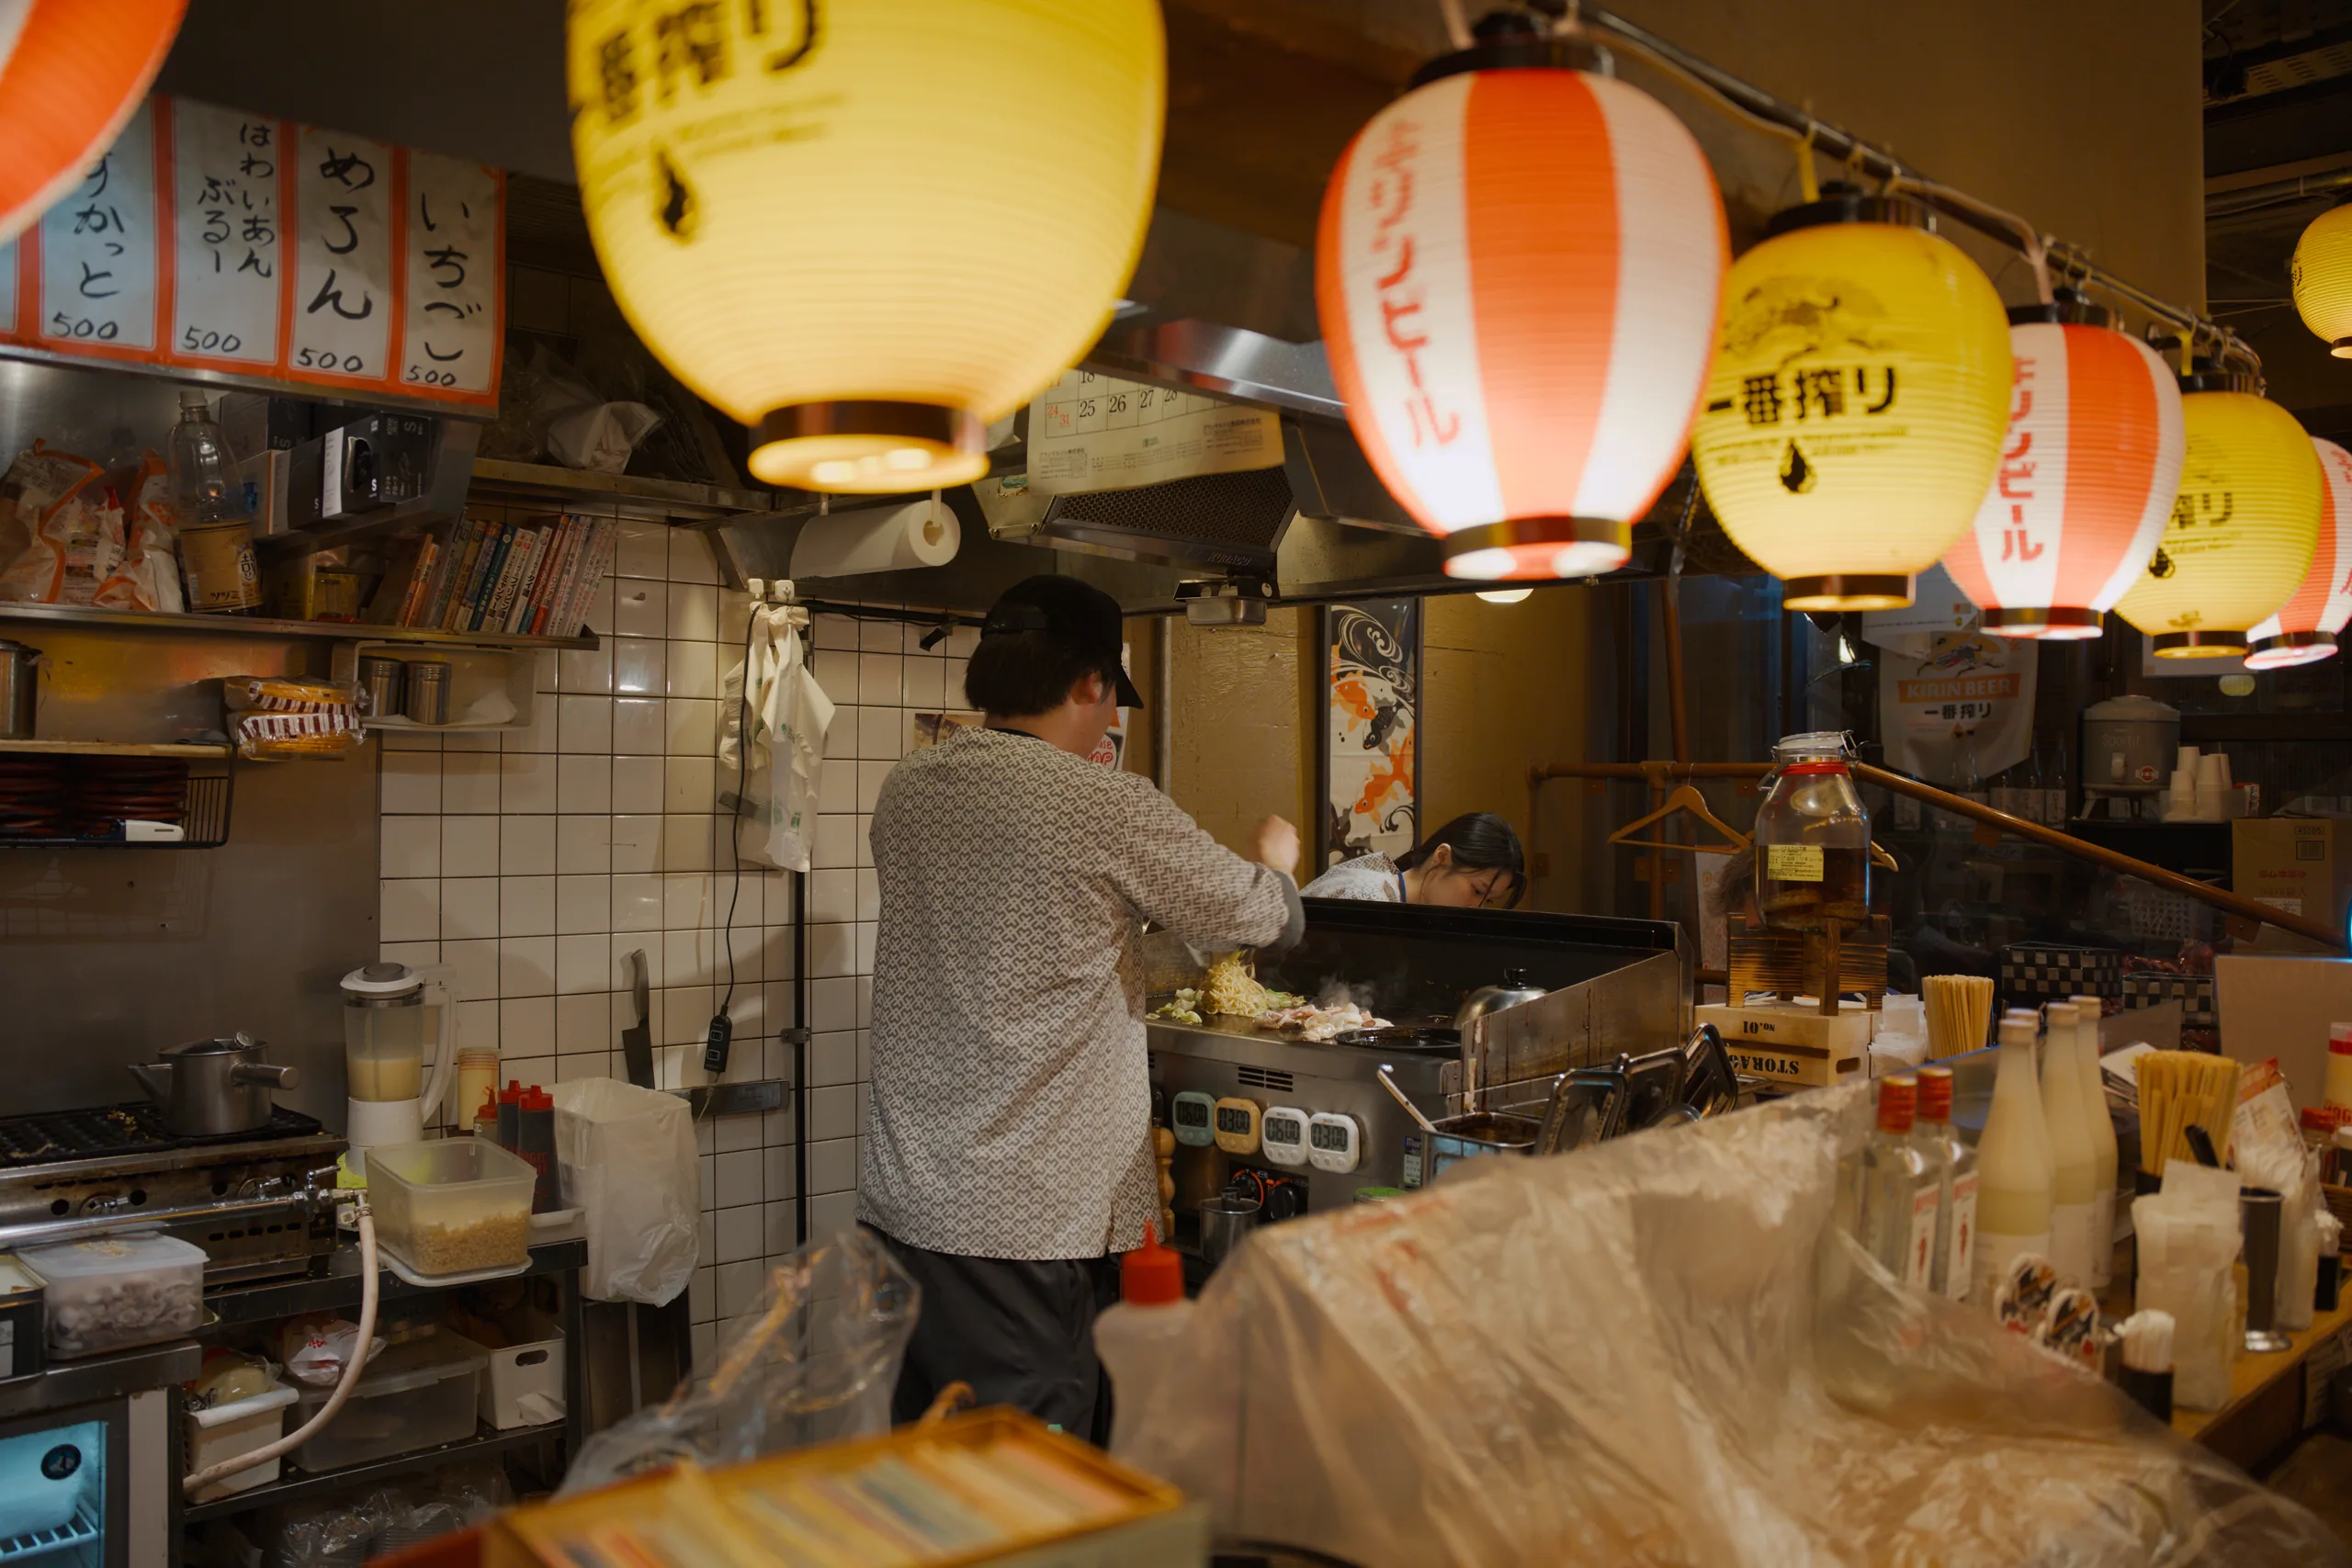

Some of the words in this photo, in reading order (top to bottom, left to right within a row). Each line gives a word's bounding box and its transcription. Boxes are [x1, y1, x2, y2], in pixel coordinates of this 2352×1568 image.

[238, 122, 275, 278] はわいあん
[74, 152, 126, 299] すかっと
[197, 175, 236, 274] ぶるー
[306, 147, 375, 321] めろん
[421, 191, 482, 362] いちご
[51, 310, 119, 341] 500
[182, 326, 242, 355] 500
[297, 347, 364, 374] 500
[405, 365, 458, 388] 500
[1079, 400, 1096, 418] 25
[1109, 394, 1127, 414] 26
[1139, 389, 1155, 409] 27
[1707, 367, 1897, 426] 一番搾り
[1906, 681, 1961, 699] KIRIN
[1964, 678, 2012, 696] BEER
[1924, 703, 1992, 720] 一番搾り
[1728, 1054, 1799, 1075] STORAG
